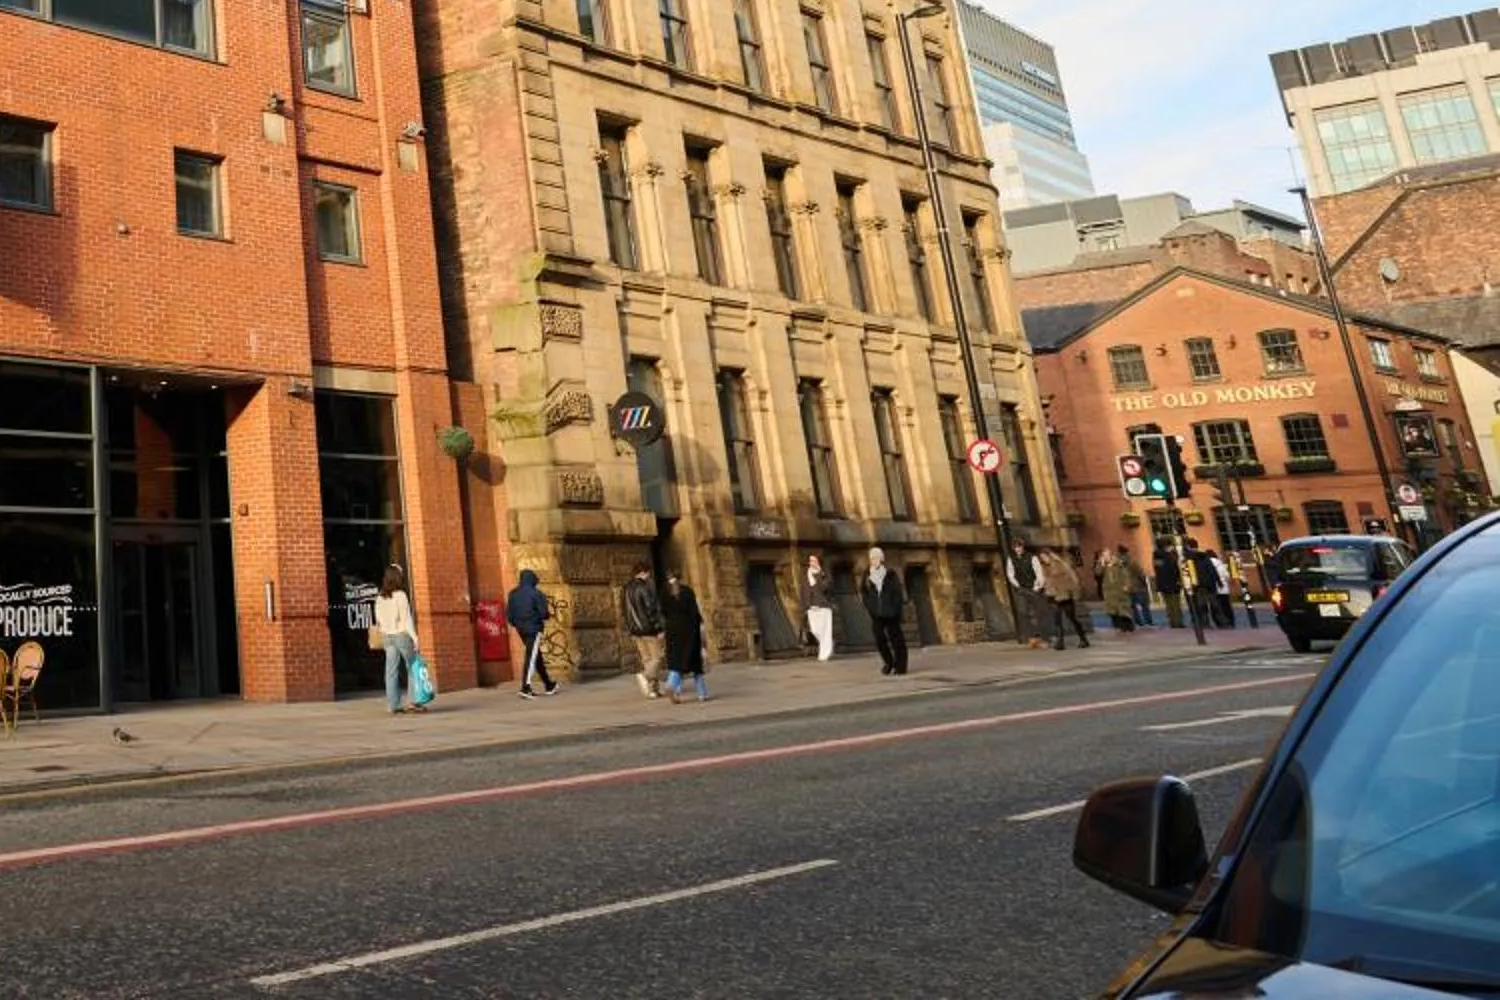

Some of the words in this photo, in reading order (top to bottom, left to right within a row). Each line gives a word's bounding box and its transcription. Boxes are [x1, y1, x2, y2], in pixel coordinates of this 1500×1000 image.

[1110, 395, 1156, 412] THE
[1162, 391, 1208, 409] OLD
[1214, 381, 1317, 404] MONKEY
